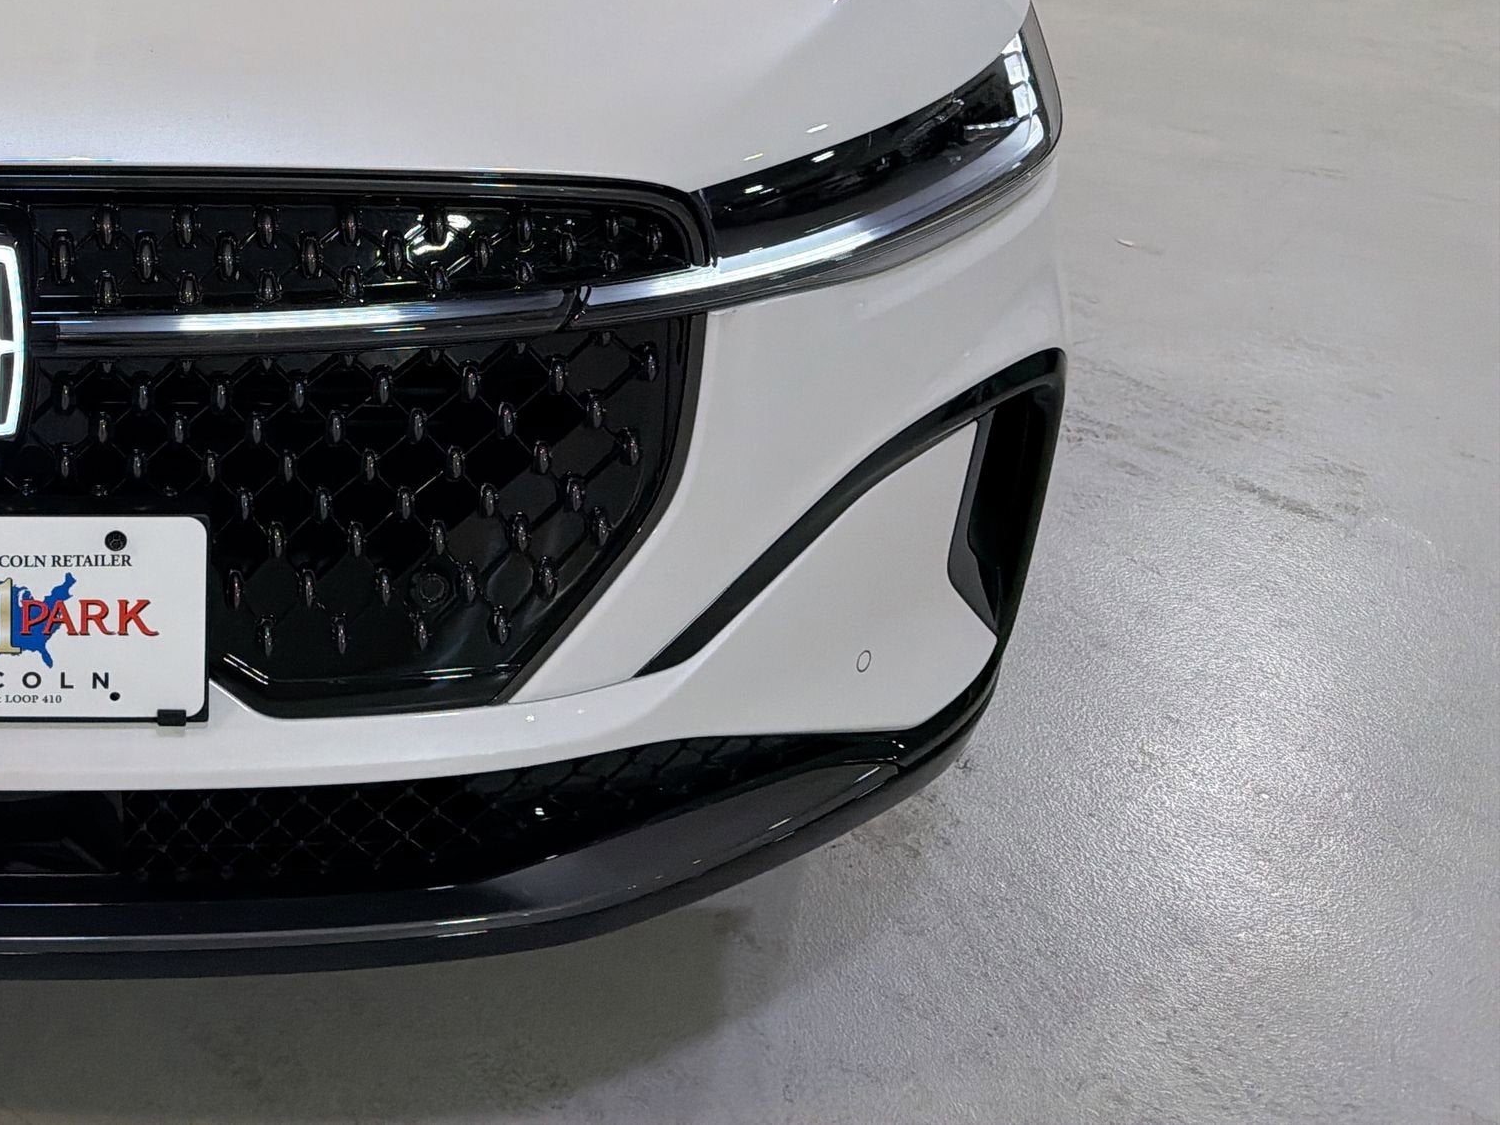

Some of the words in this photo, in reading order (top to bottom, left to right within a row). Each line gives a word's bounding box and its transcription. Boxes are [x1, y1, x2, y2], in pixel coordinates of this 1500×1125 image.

[52, 554, 133, 568] RETAILER
[21, 598, 160, 636] PARK
[4, 694, 39, 704] LOOP
[42, 694, 62, 704] 410
